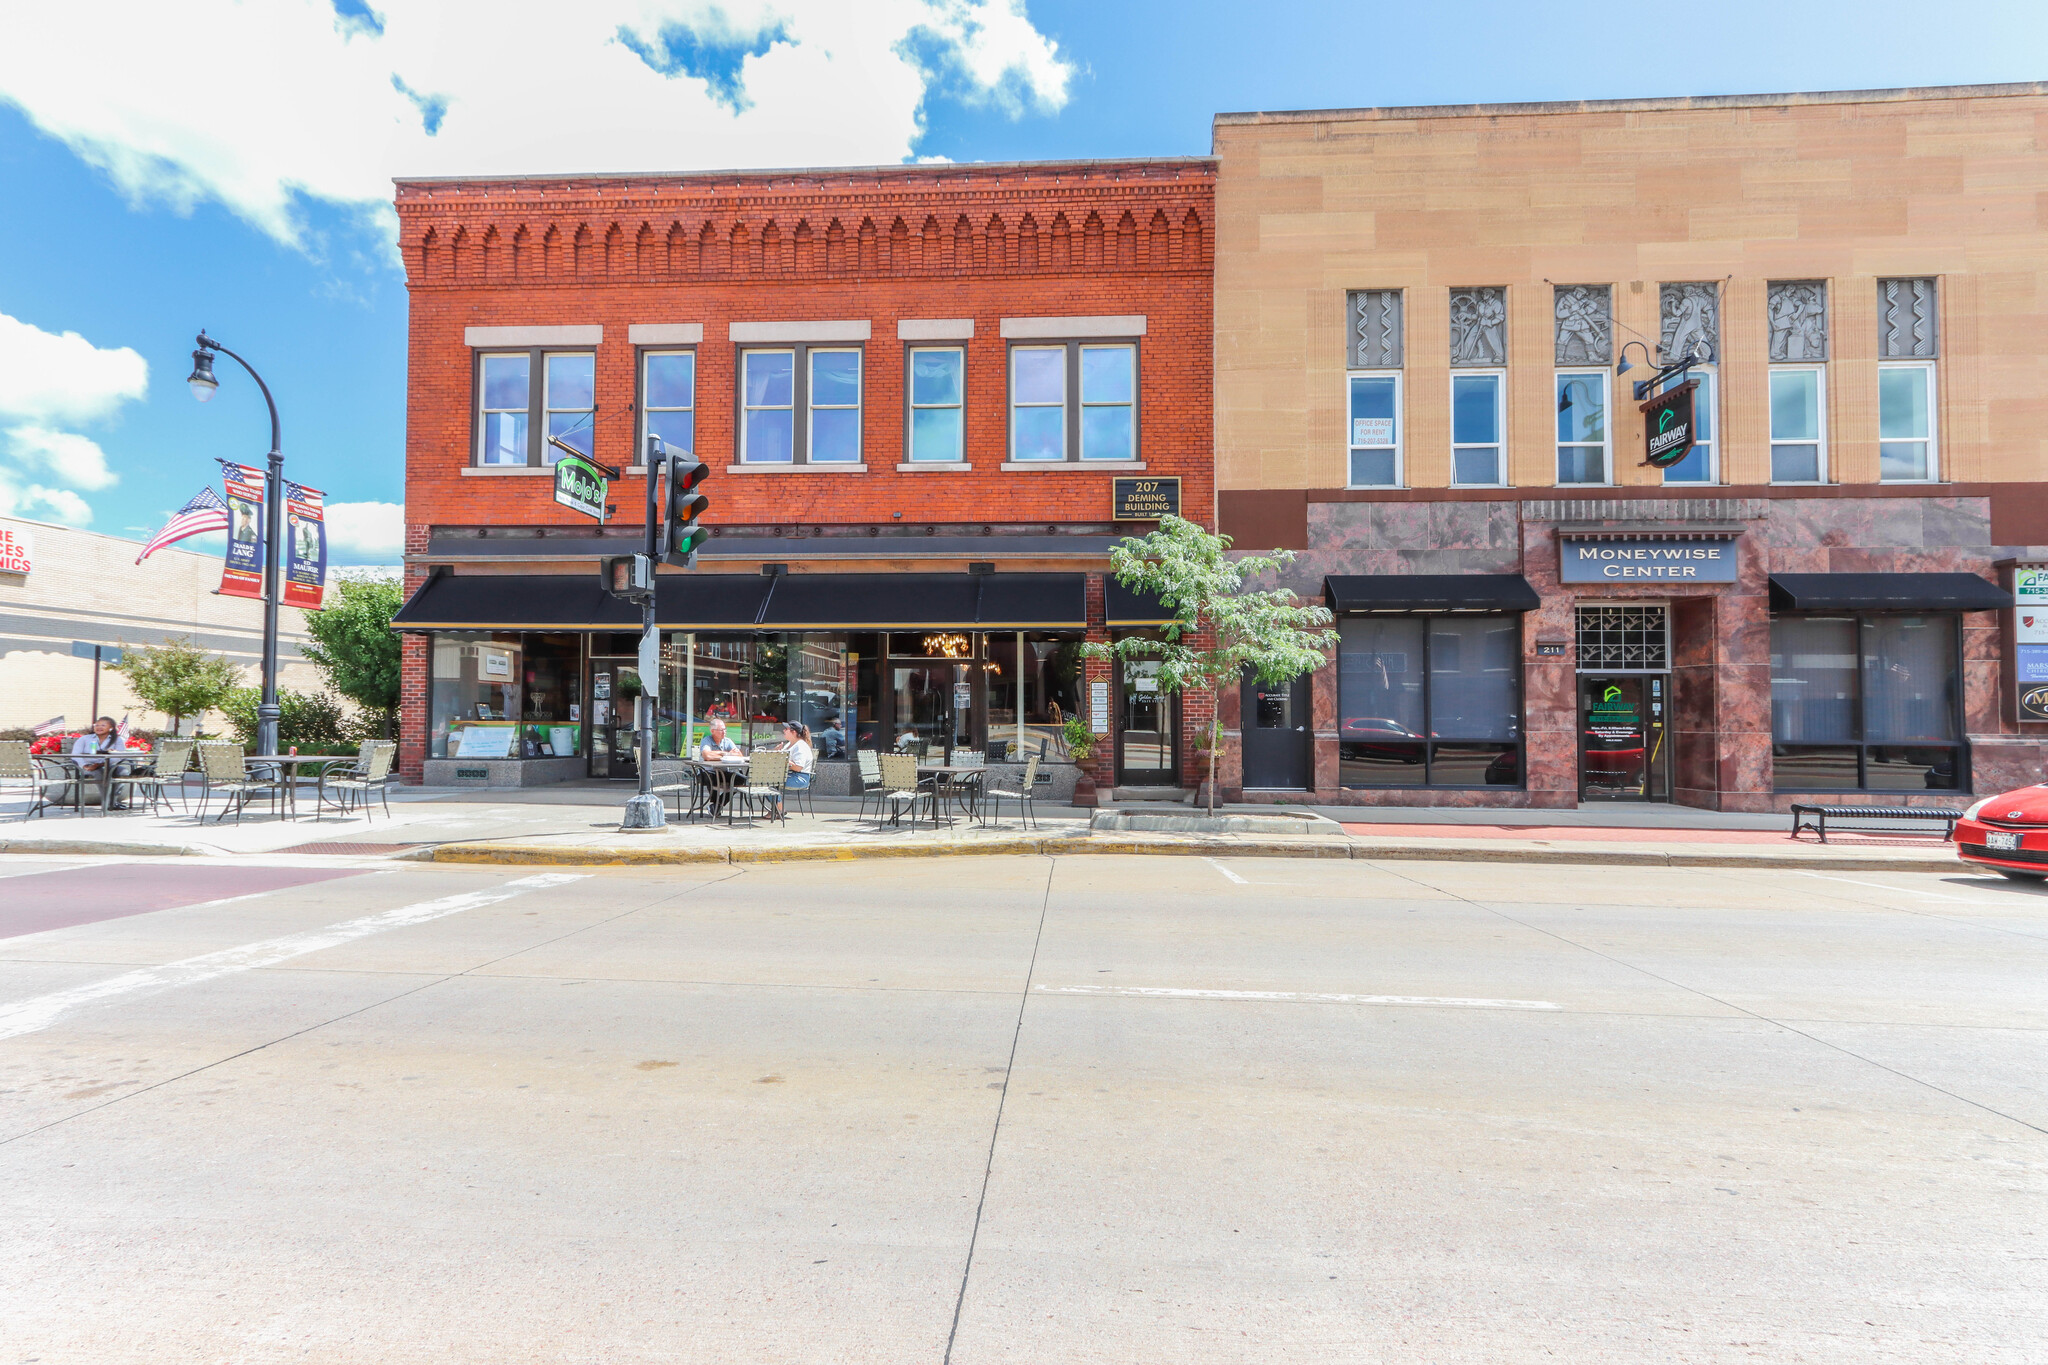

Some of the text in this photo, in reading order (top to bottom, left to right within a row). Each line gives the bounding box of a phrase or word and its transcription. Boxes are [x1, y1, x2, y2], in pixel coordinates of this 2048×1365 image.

[1650, 423, 1688, 450] FAIRWAY
[1136, 481, 1159, 492] 207
[1128, 494, 1166, 502] DEMING
[1125, 503, 1170, 511] BUILDING
[232, 547, 254, 558] LANG
[1579, 547, 1721, 560] MONEYWISE
[1603, 564, 1697, 577] CENTER
[1543, 646, 1560, 654] 211
[1593, 703, 1635, 711] FAIRWAY
